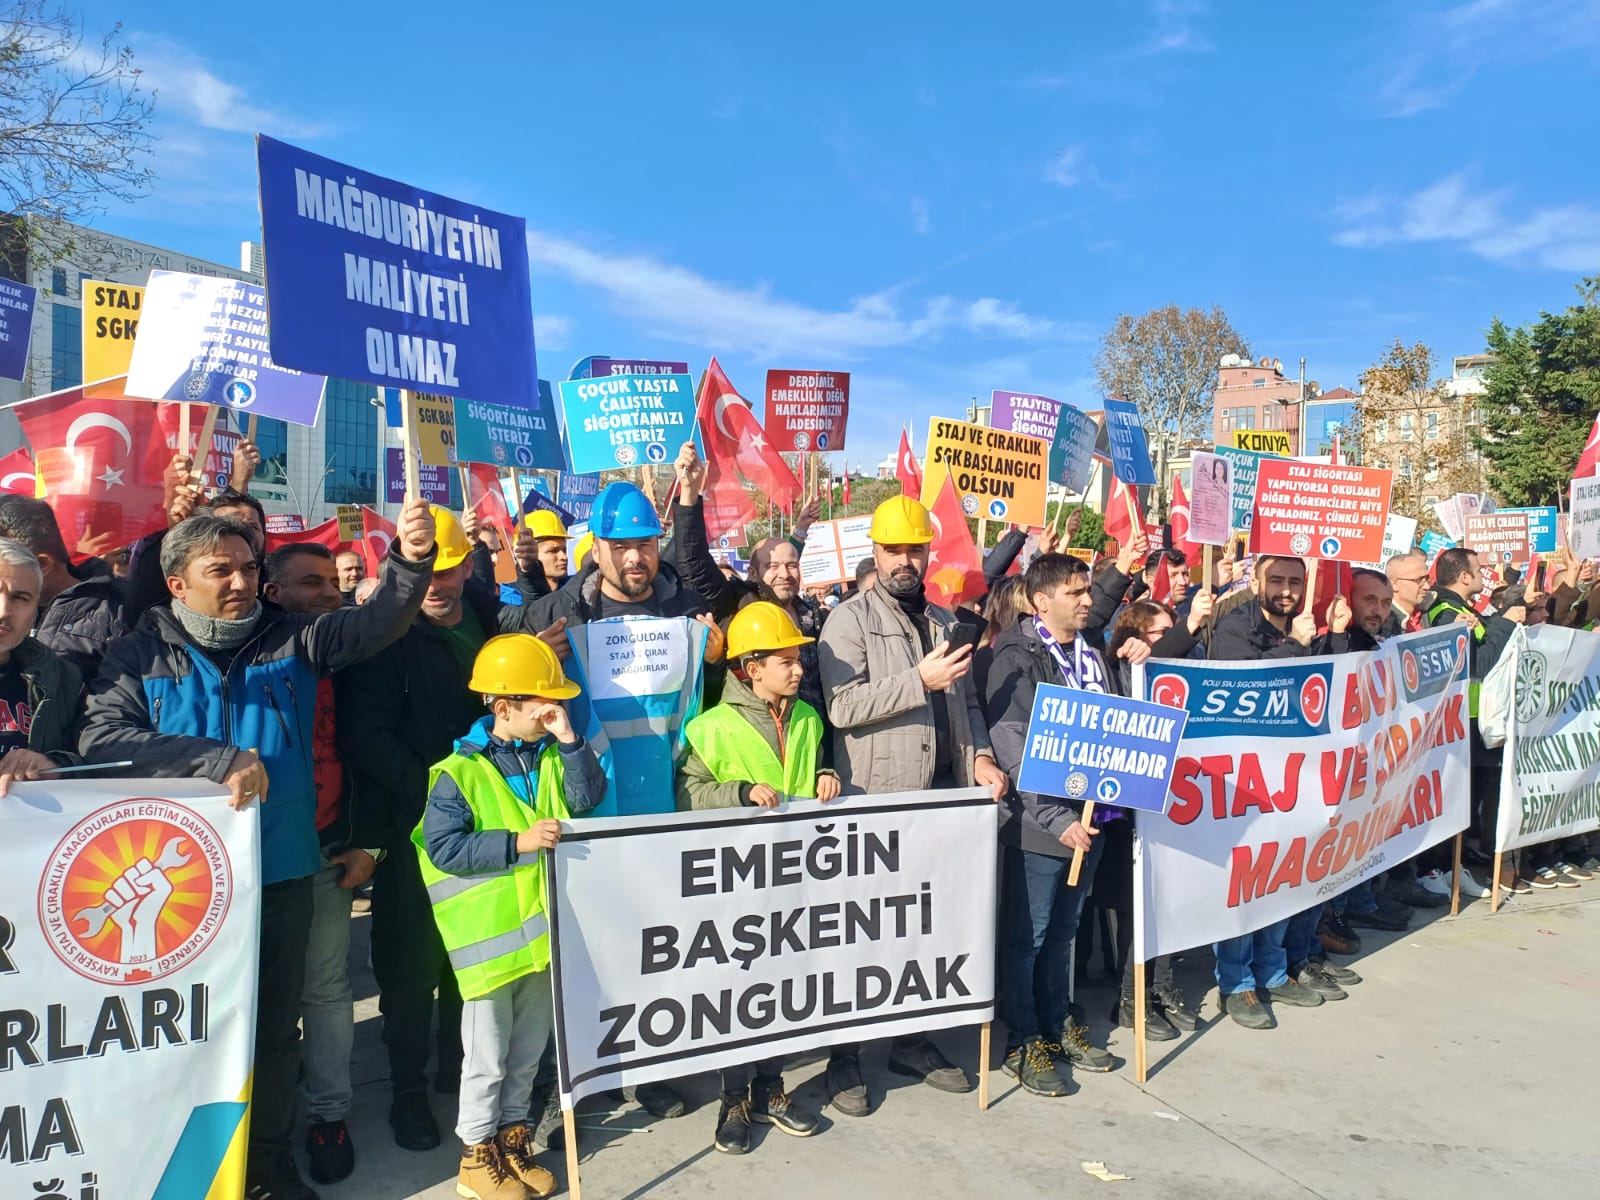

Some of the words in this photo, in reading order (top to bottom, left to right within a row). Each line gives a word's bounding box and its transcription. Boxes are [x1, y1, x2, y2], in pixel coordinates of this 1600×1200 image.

[294, 168, 502, 270] MAĞDURİYETİN
[95, 286, 141, 311] STAJ
[248, 292, 265, 305] VE
[344, 252, 469, 326] MALİYETİ
[366, 327, 459, 388] OLMAZ
[633, 379, 679, 397] YAŞTA
[789, 373, 835, 388] DERDİMİZ
[771, 387, 824, 402] EMEKLİLİK
[1009, 396, 1052, 413] STAJYER
[468, 401, 547, 430] SİGORTAMIZI
[583, 411, 684, 433] SİGORTAMIZI
[775, 404, 842, 416] HAKLARIMIZIN
[487, 422, 532, 446] İSTERİZ
[609, 425, 666, 446] İSTERİZ
[936, 422, 966, 442] STAJ
[969, 428, 983, 445] VE
[986, 432, 1042, 457] ÇIRAKLIK
[1237, 433, 1291, 453] KONYA
[1288, 466, 1311, 478] STAJ
[1313, 465, 1363, 482] SİGORTASI
[958, 473, 1015, 499] OLSUN
[1267, 479, 1328, 494] YAPILIYORSA
[1331, 485, 1381, 498] OKULDAKİ
[1325, 510, 1359, 525] ÇÜNKÜ
[1359, 500, 1382, 512] NİYE
[1469, 518, 1485, 529] STAJ
[1487, 518, 1496, 528] VE
[606, 631, 670, 646] ZONGULDAK
[609, 652, 630, 660] STAJ
[644, 648, 668, 657] ÇIRAK
[1421, 648, 1454, 677] SSM
[1039, 697, 1078, 726] STAJ
[1080, 703, 1101, 730] VE
[1102, 707, 1176, 743] ÇIRAKLIK
[1030, 729, 1068, 764] FİİLİ
[1168, 752, 1305, 825] STAJ
[1321, 744, 1369, 805] VE
[138, 803, 180, 822] EĞİTİM
[63, 806, 135, 860] MAĞDURLARI
[180, 815, 222, 871] DAYANIŞMA
[681, 823, 900, 898] EMEĞİN
[47, 860, 67, 915] ÇIRAKLIK
[215, 875, 225, 888] VE
[49, 916, 62, 930] VE
[204, 890, 225, 934] KÜLTÜR
[57, 925, 77, 955] STAJ
[641, 881, 932, 975] BAŞKENTİ
[129, 954, 148, 963] 2023
[157, 933, 205, 971] DERNEĞİ
[74, 952, 120, 977] KAYSERİ
[597, 953, 971, 1059] ZONGULDAK
